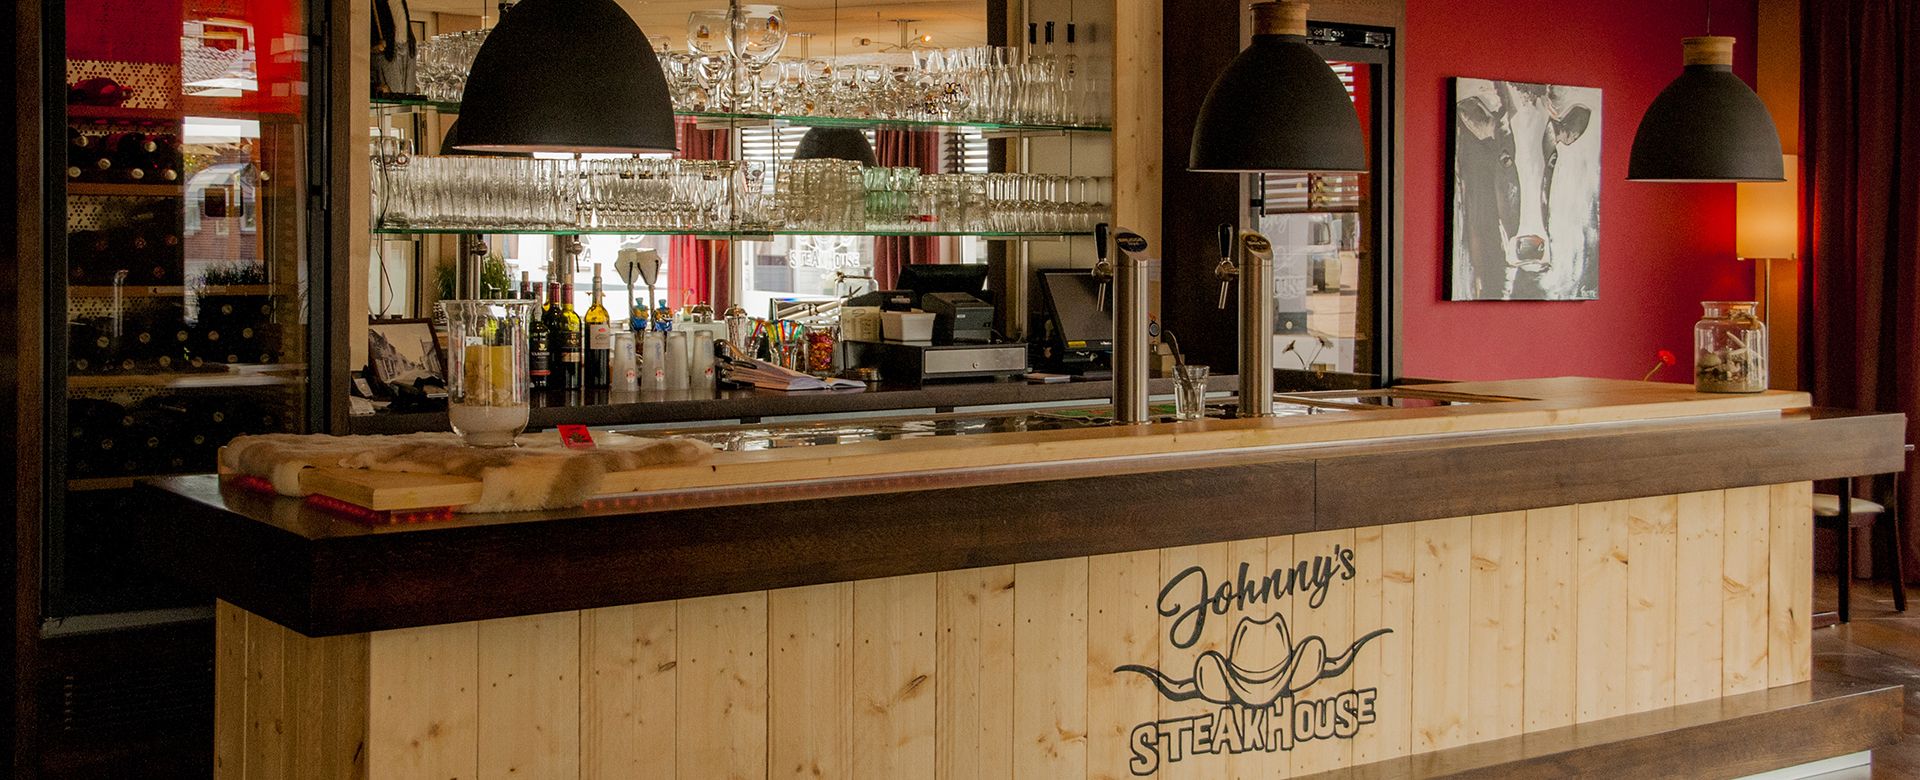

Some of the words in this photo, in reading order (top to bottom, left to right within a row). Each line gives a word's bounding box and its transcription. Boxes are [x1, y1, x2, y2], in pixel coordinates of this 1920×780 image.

[789, 249, 860, 271] STEAOUSE
[1156, 544, 1356, 649] Johnny's
[1129, 687, 1378, 777] STEAKHOUSE
